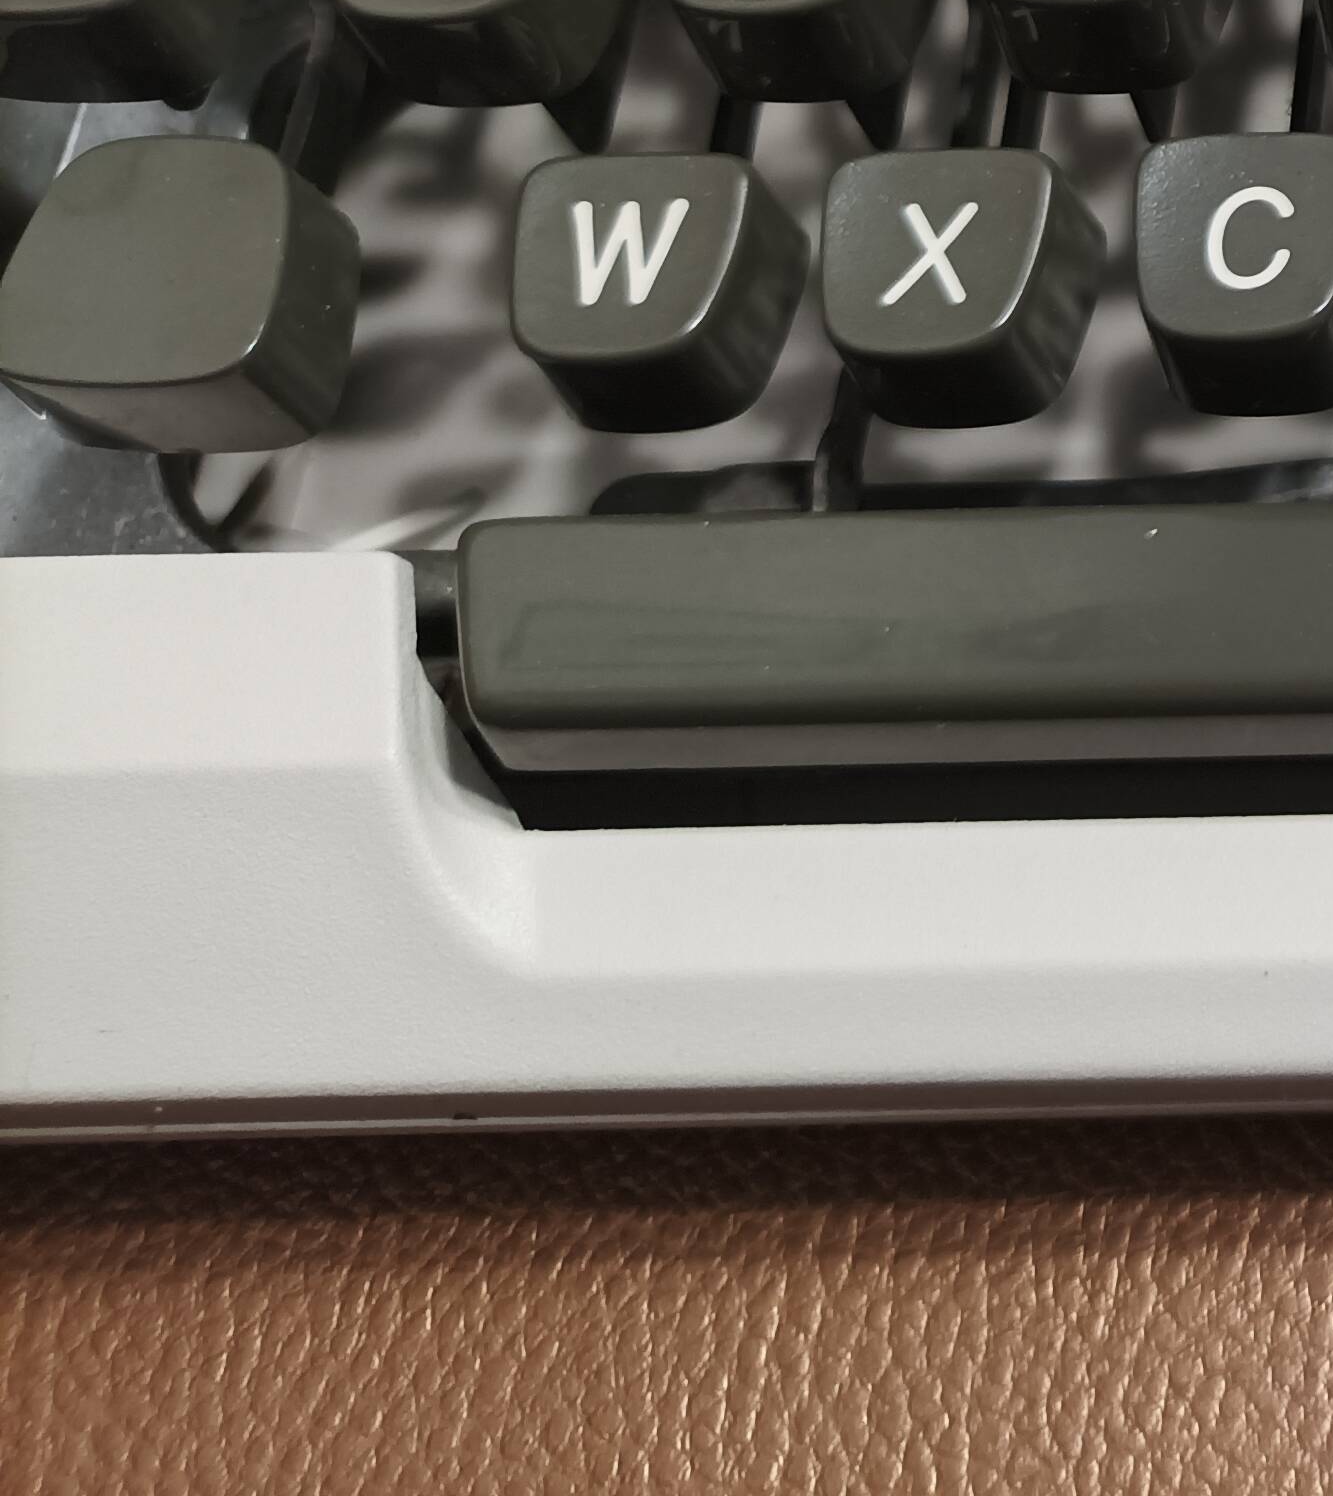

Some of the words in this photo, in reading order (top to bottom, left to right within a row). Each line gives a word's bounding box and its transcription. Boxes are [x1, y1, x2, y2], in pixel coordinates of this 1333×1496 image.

[572, 198, 690, 306] W
[881, 202, 979, 306] X
[1206, 186, 1295, 290] C
